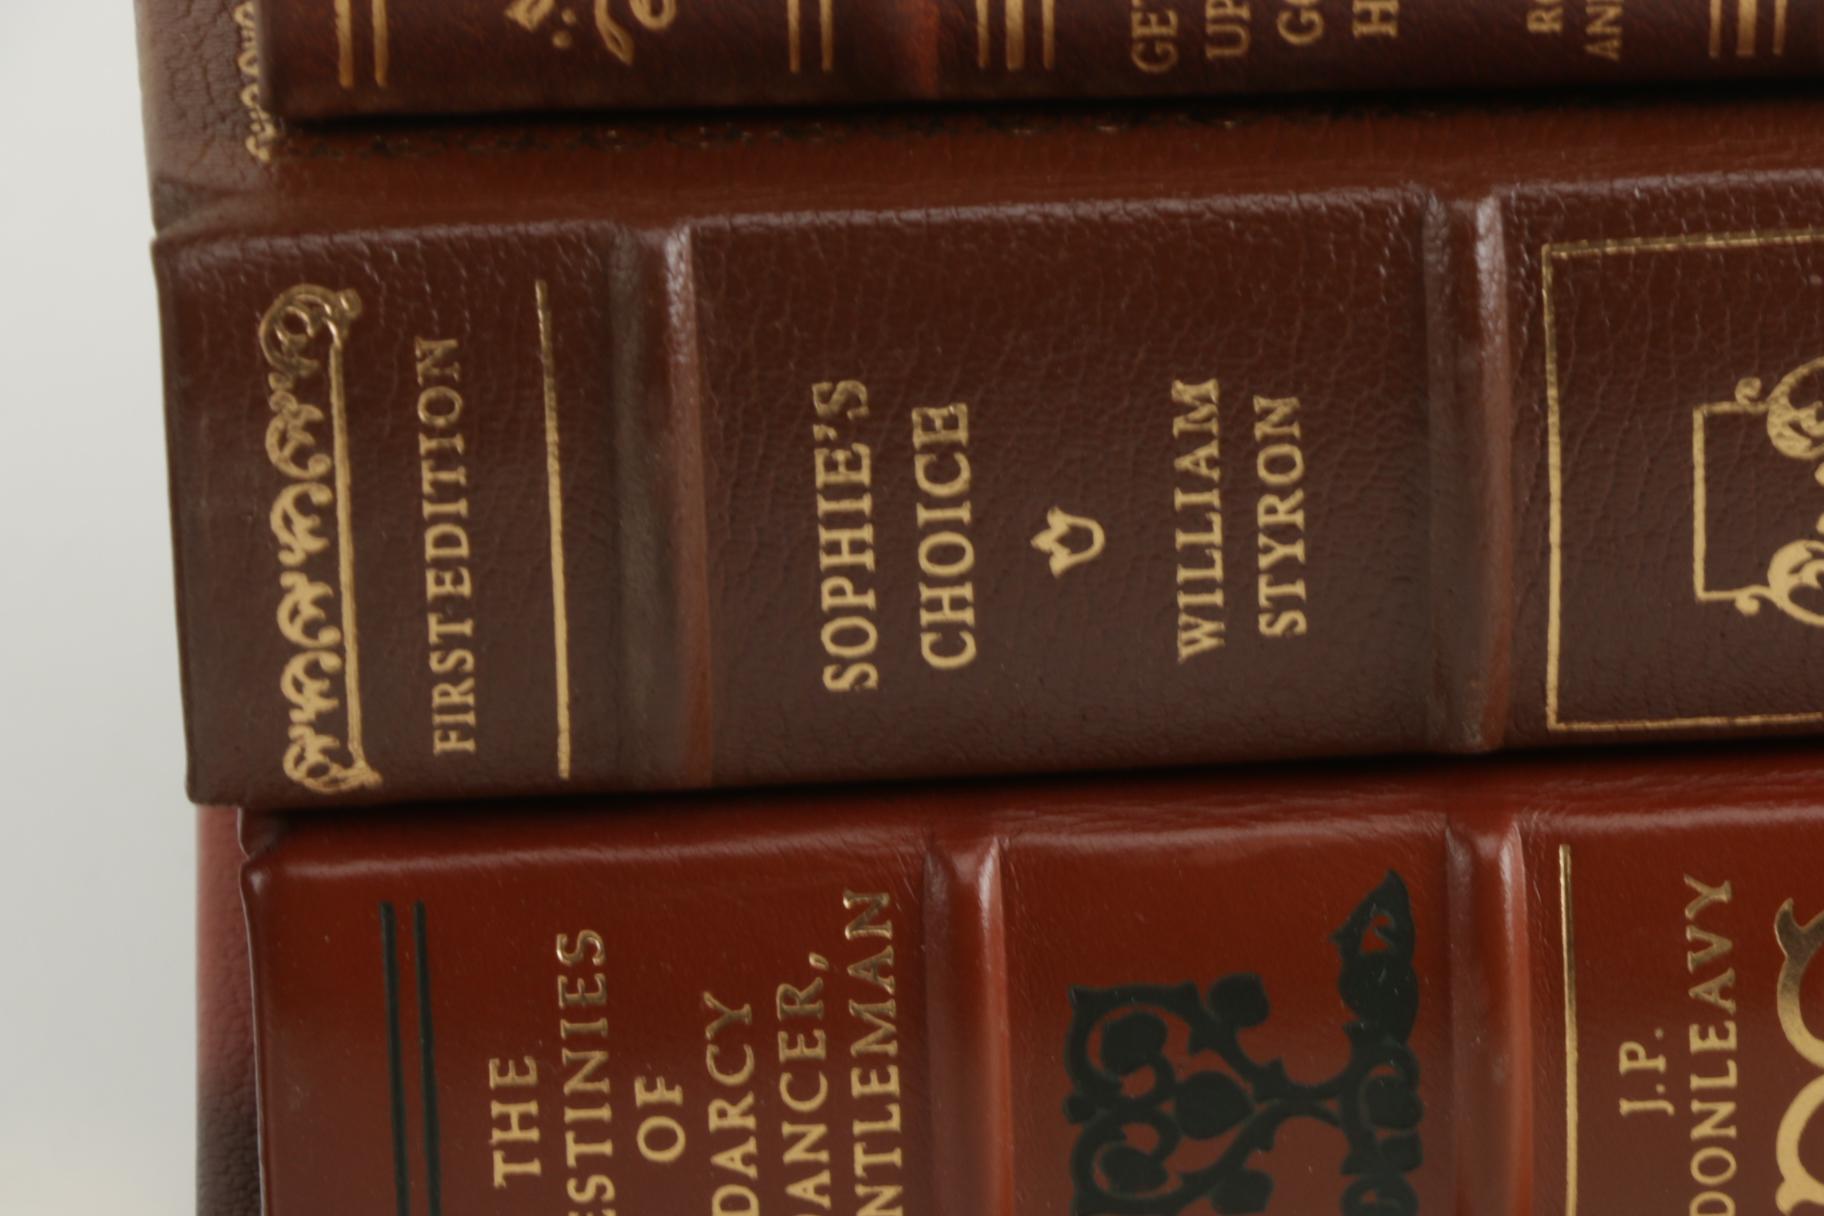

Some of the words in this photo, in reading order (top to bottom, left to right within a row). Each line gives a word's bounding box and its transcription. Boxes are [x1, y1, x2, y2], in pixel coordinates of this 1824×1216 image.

[414, 337, 473, 602] EDITION
[811, 380, 879, 692] SOPHIE'S
[910, 402, 977, 670] CHOICE
[1170, 378, 1226, 662] WILLIAM
[1252, 395, 1308, 637] STYRON
[427, 612, 477, 755] FIRST
[488, 1055, 542, 1188] THE
[633, 1076, 686, 1163] OF
[1618, 1028, 1675, 1116] J.P.
